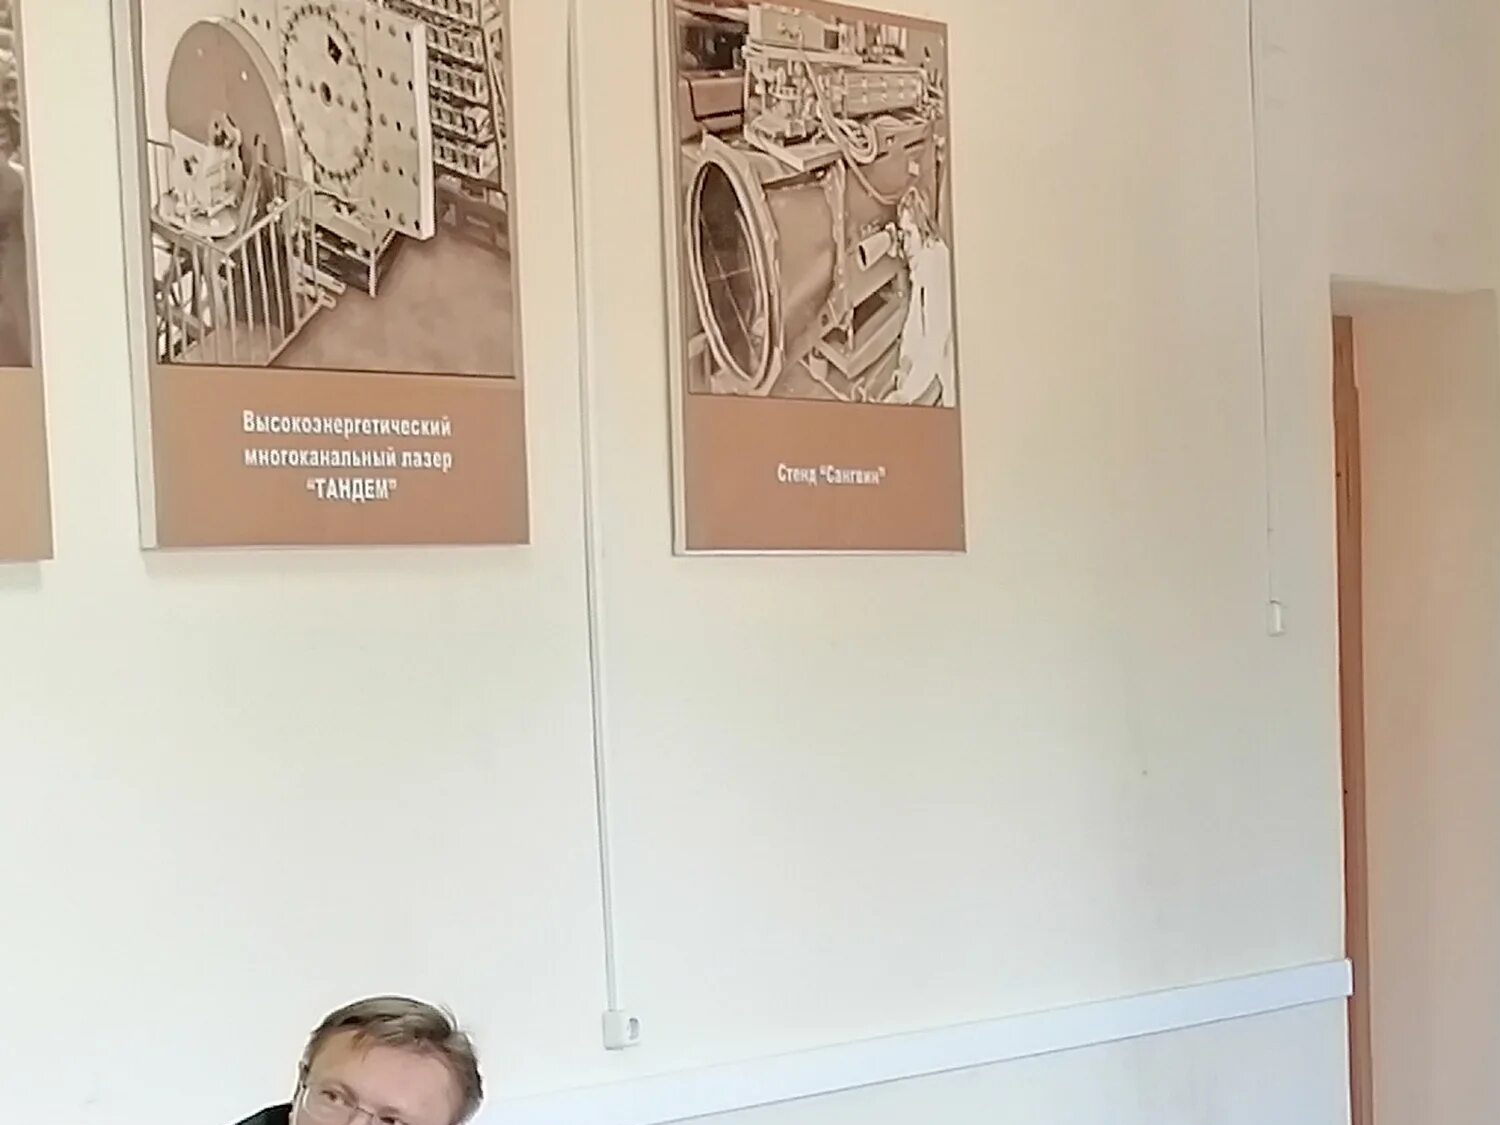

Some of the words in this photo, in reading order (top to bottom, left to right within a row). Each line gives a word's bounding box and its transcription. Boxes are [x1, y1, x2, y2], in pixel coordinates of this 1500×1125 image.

[242, 410, 452, 439] Высокоэнергетический
[244, 446, 397, 467] многоканальный
[400, 451, 453, 473] лазер
[778, 462, 818, 487] Стенд
